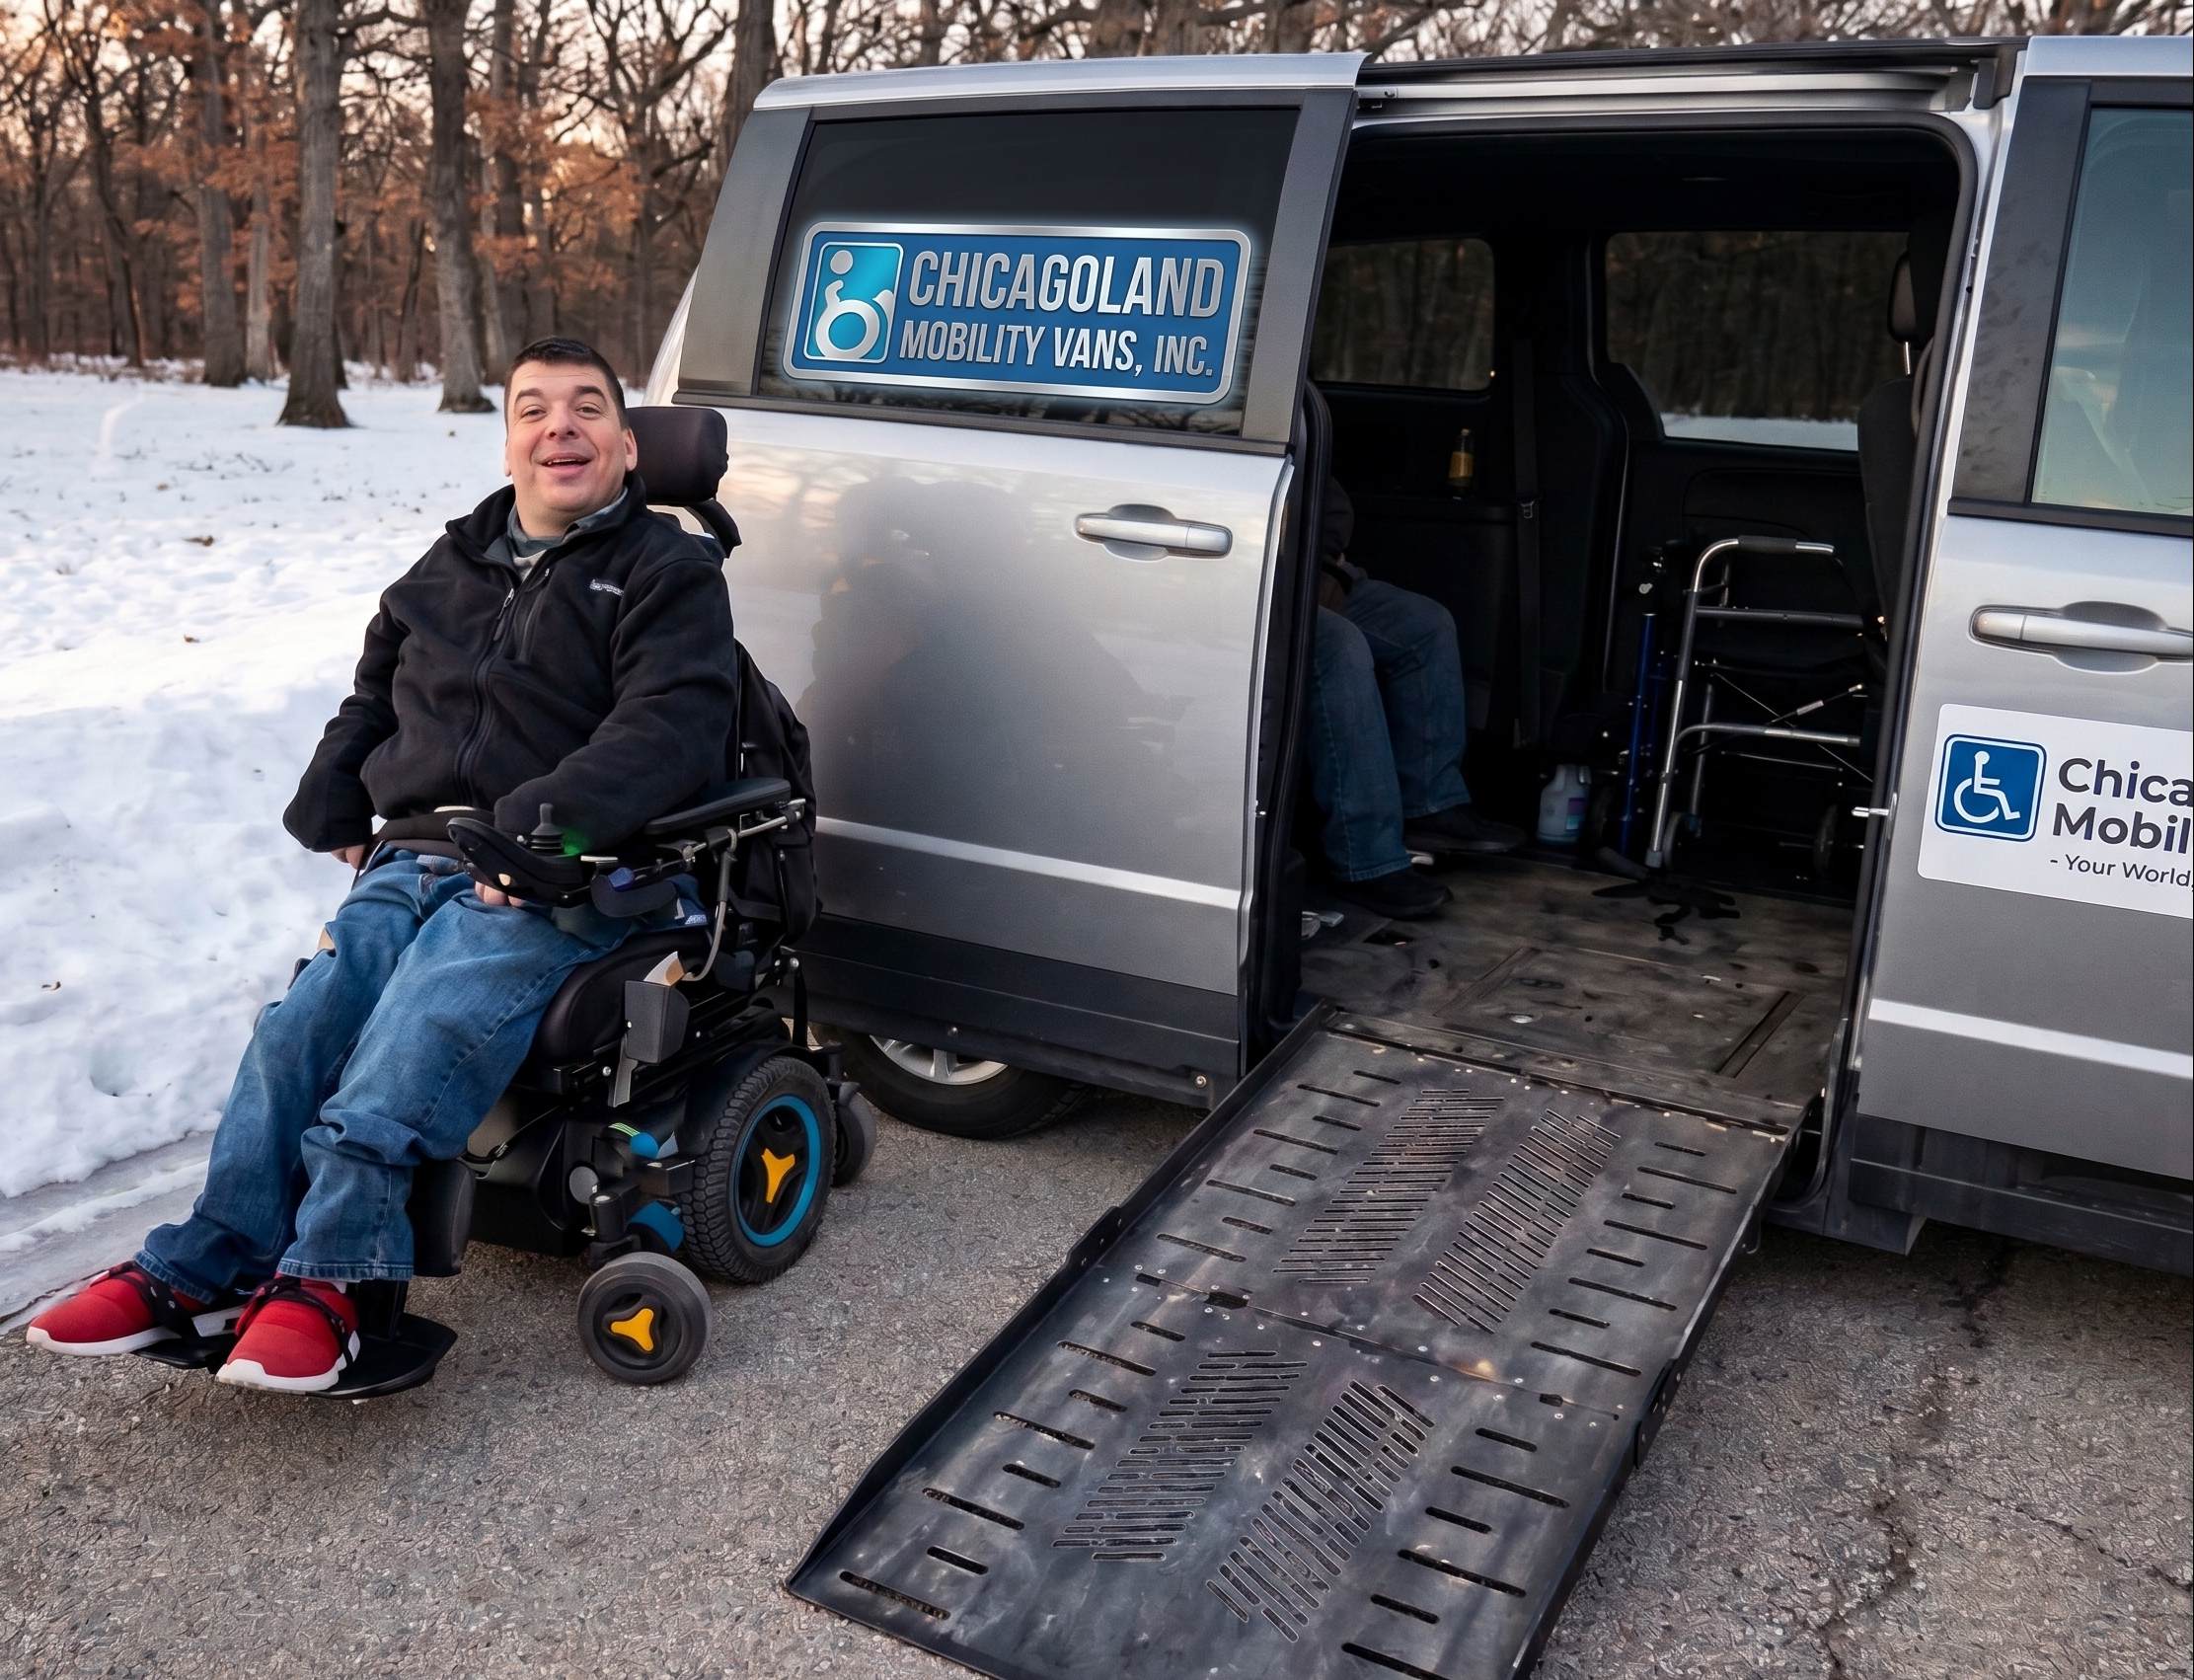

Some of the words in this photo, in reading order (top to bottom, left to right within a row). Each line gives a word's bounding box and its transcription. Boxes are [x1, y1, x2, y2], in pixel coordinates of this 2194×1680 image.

[910, 251, 1225, 318] CHICAGOLAND
[899, 320, 1046, 365] MOBILITY
[1053, 329, 1143, 377] VANS,
[1154, 336, 1214, 376] INC.
[2059, 758, 2193, 805] Chica
[2053, 802, 2191, 854] Mobil
[2065, 854, 2116, 876] Your
